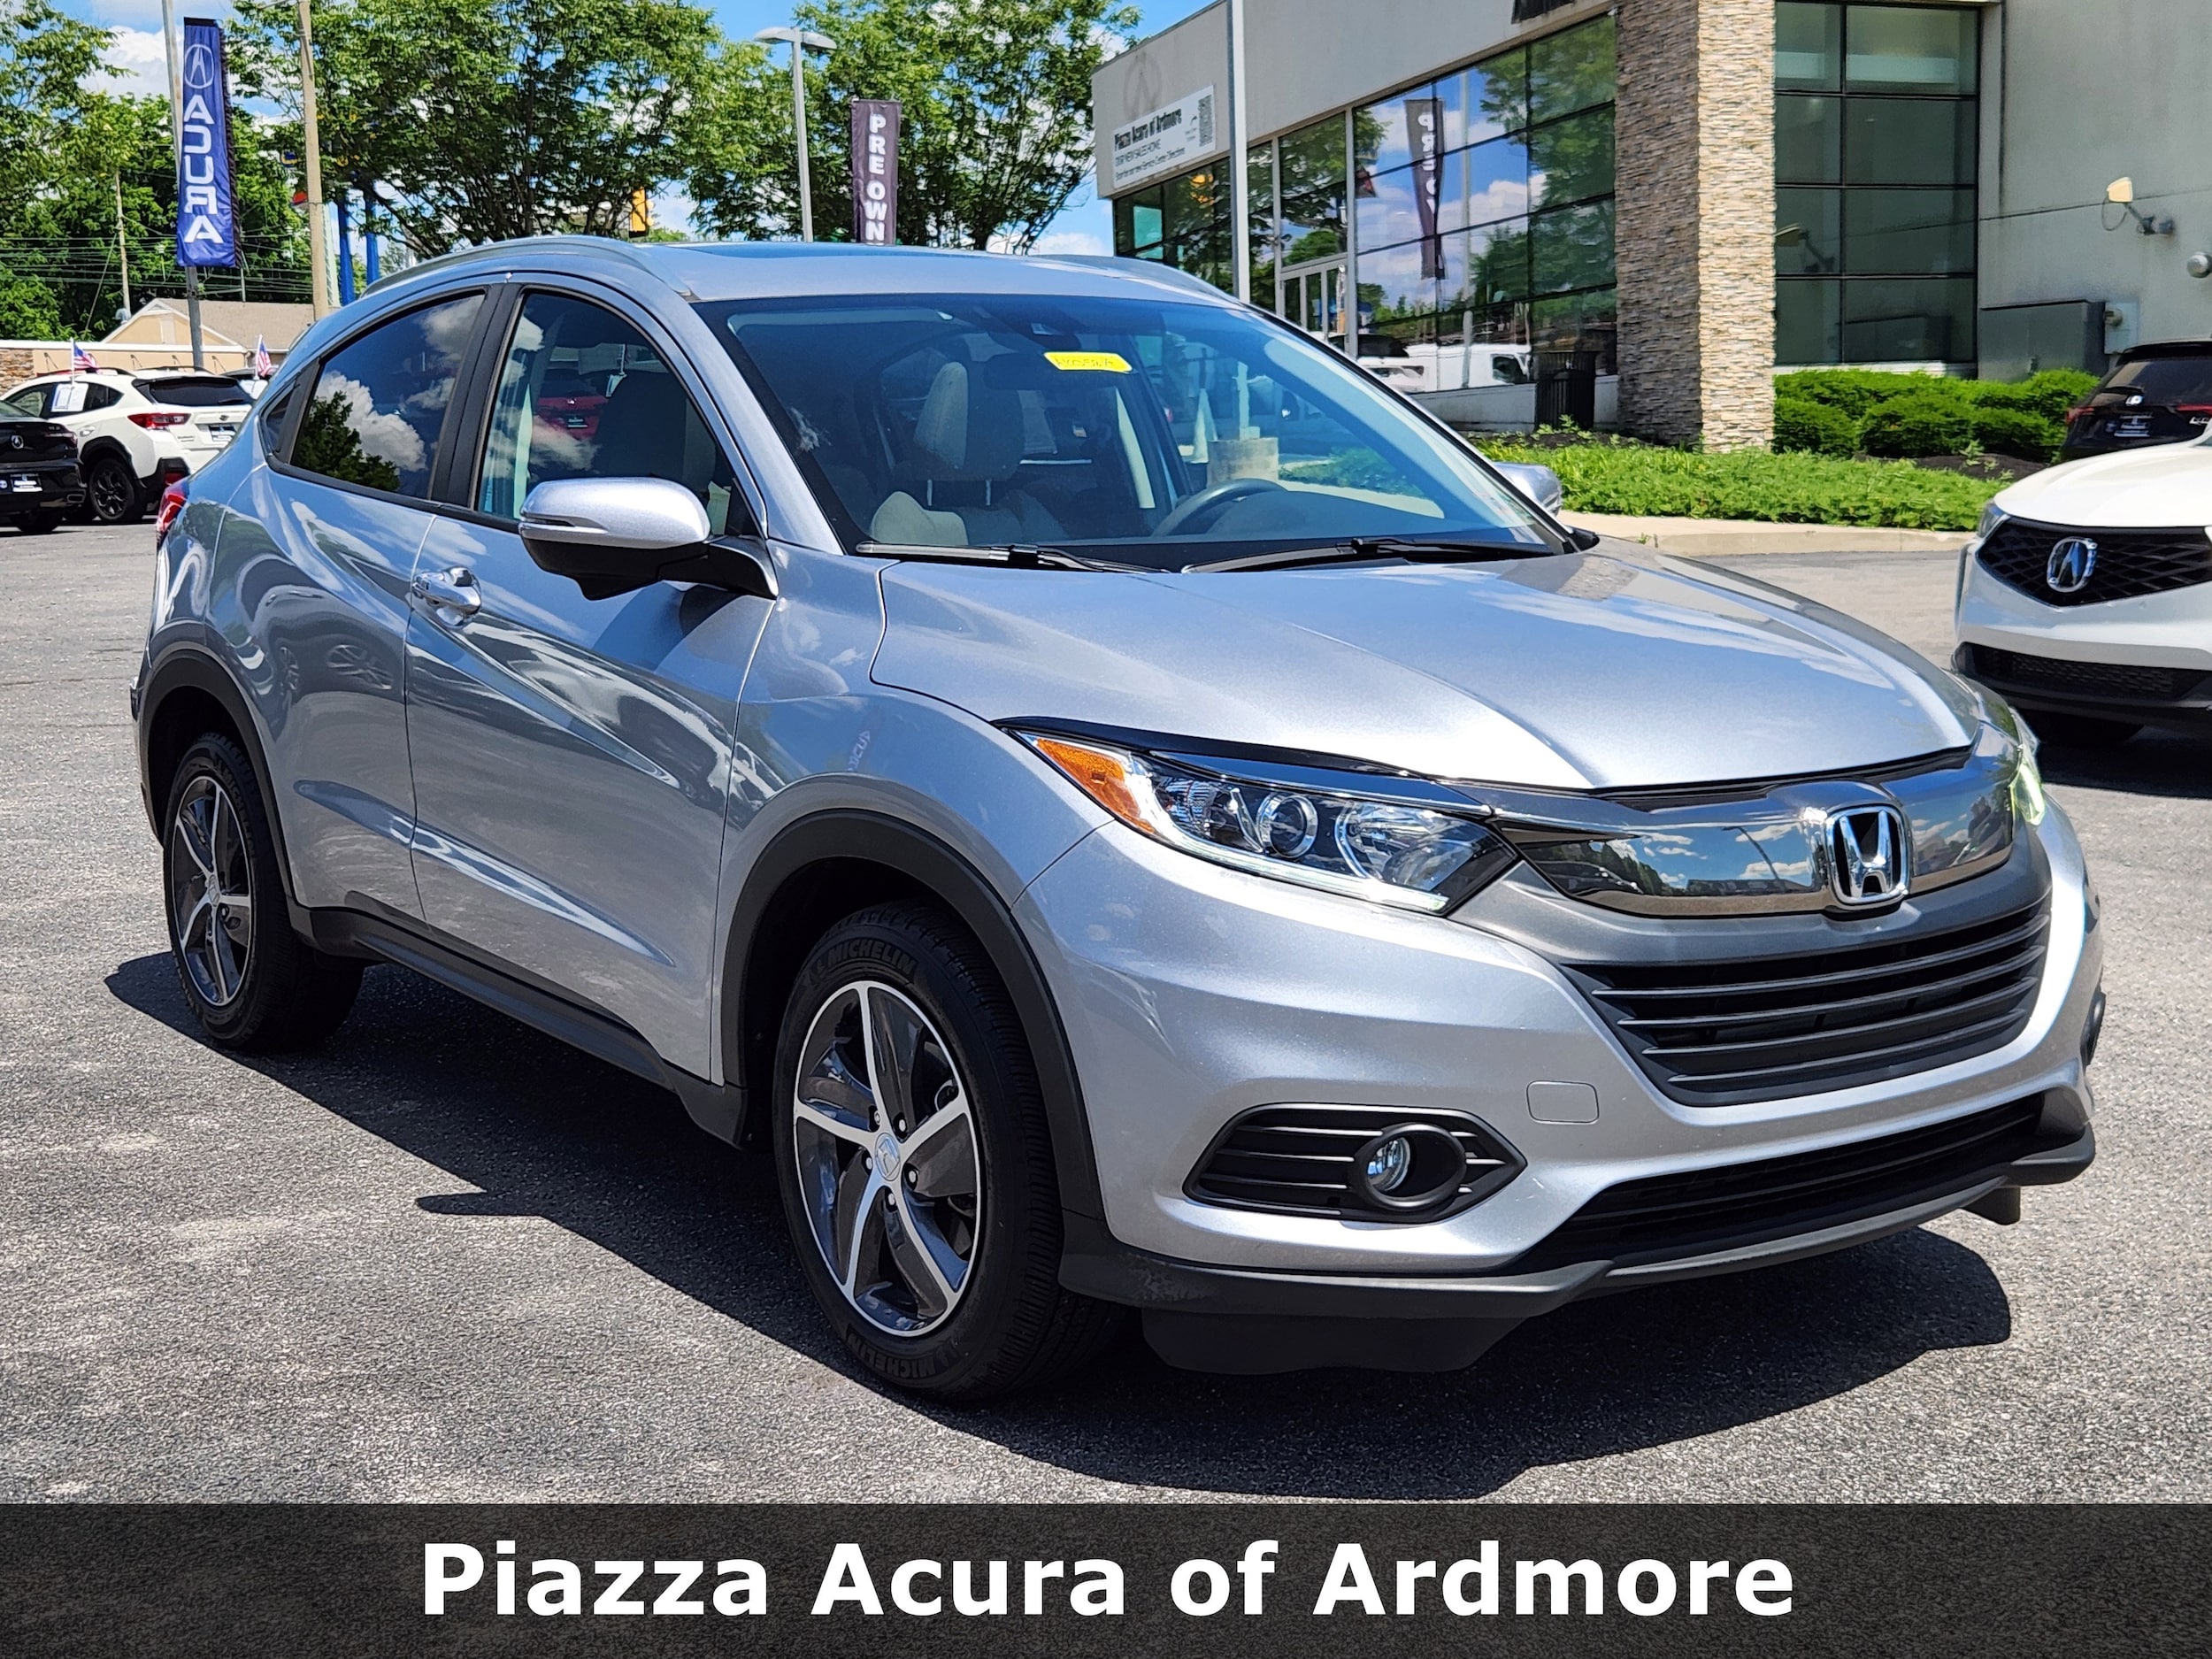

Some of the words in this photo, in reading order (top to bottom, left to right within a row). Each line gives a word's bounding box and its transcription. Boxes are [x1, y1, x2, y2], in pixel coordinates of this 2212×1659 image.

[864, 180, 887, 245] OWN
[827, 939, 917, 975] MICHELIN
[847, 1333, 936, 1379] MICHELIN
